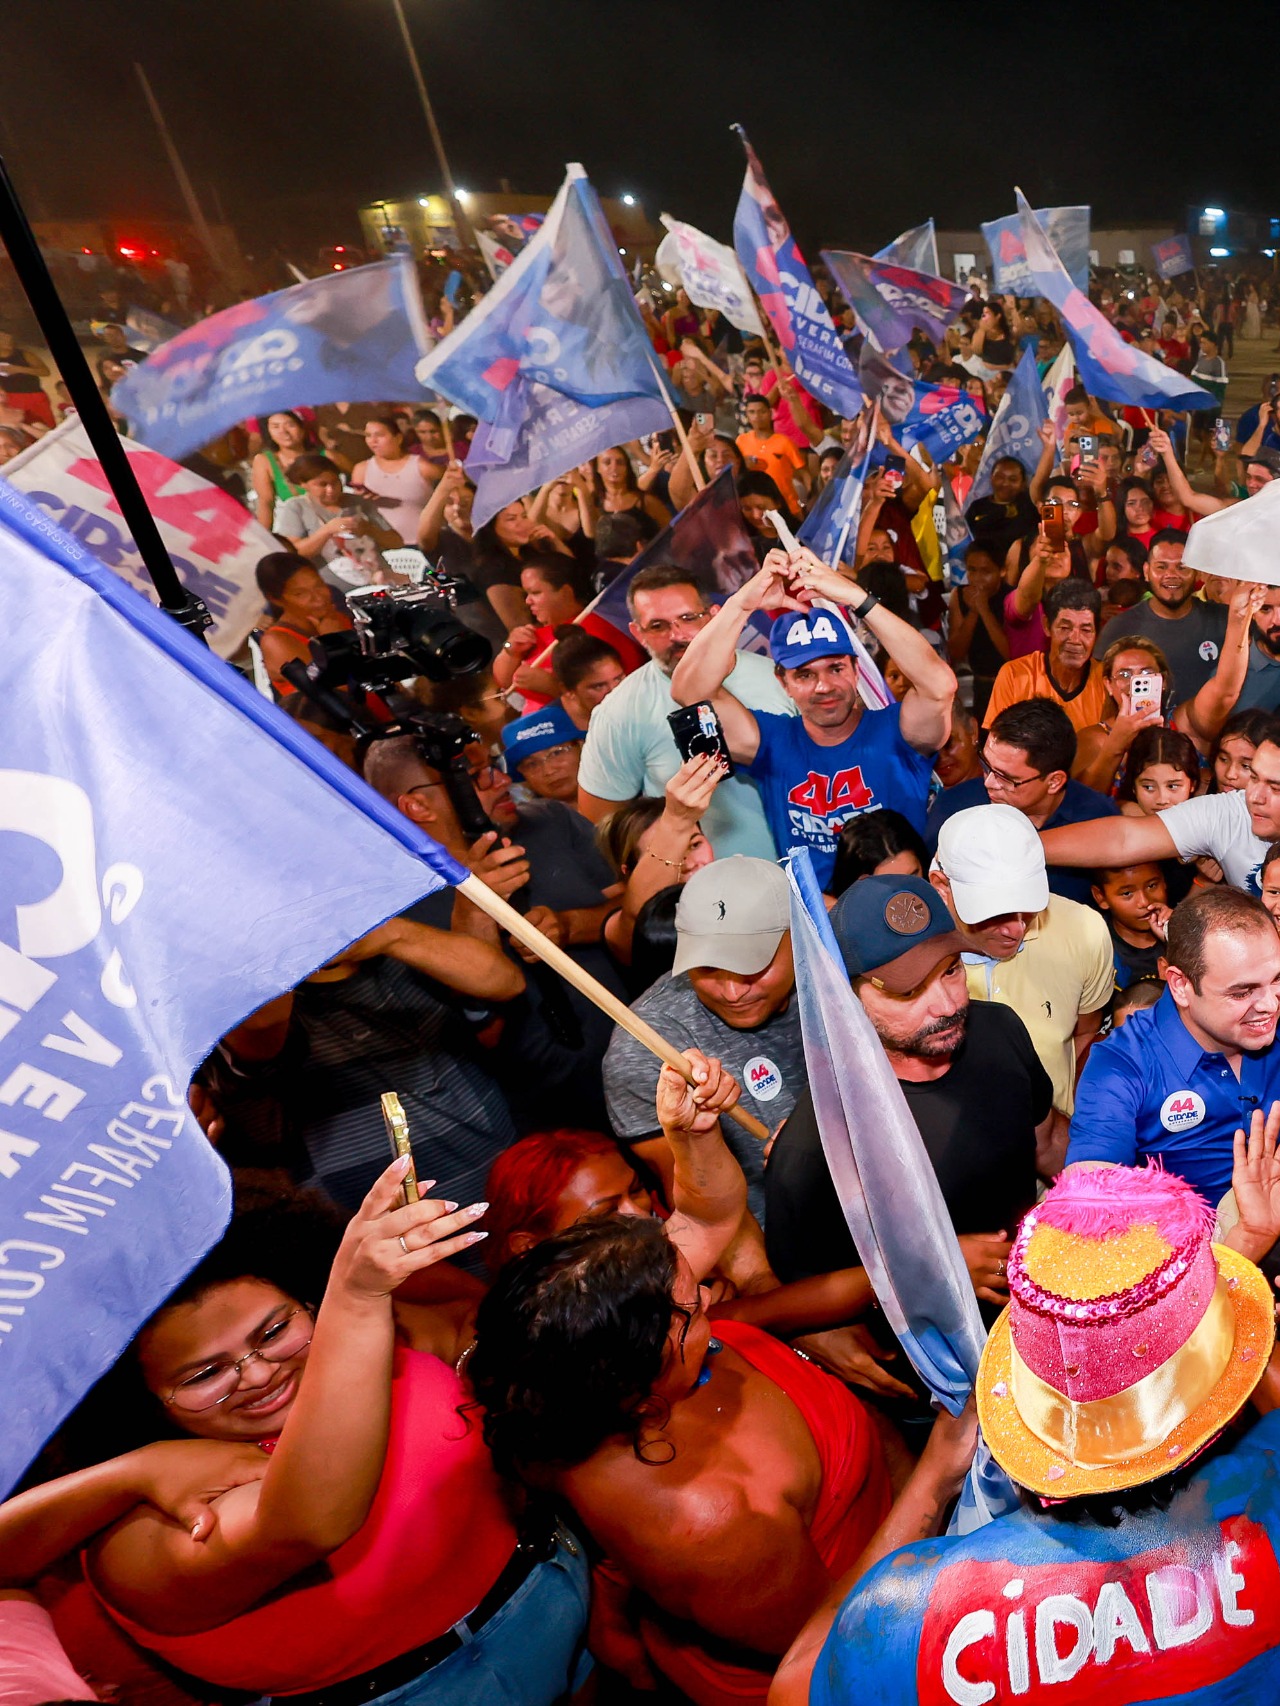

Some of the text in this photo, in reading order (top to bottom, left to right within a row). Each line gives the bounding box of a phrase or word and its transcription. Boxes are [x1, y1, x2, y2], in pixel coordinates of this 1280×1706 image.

[786, 617, 838, 646] 44
[787, 765, 874, 818] 44
[788, 803, 883, 836] CIDA
[751, 1064, 769, 1082] 44
[753, 1074, 776, 1092] CIDADE
[1170, 1098, 1195, 1113] 44
[1167, 1111, 1199, 1123] CIDADE
